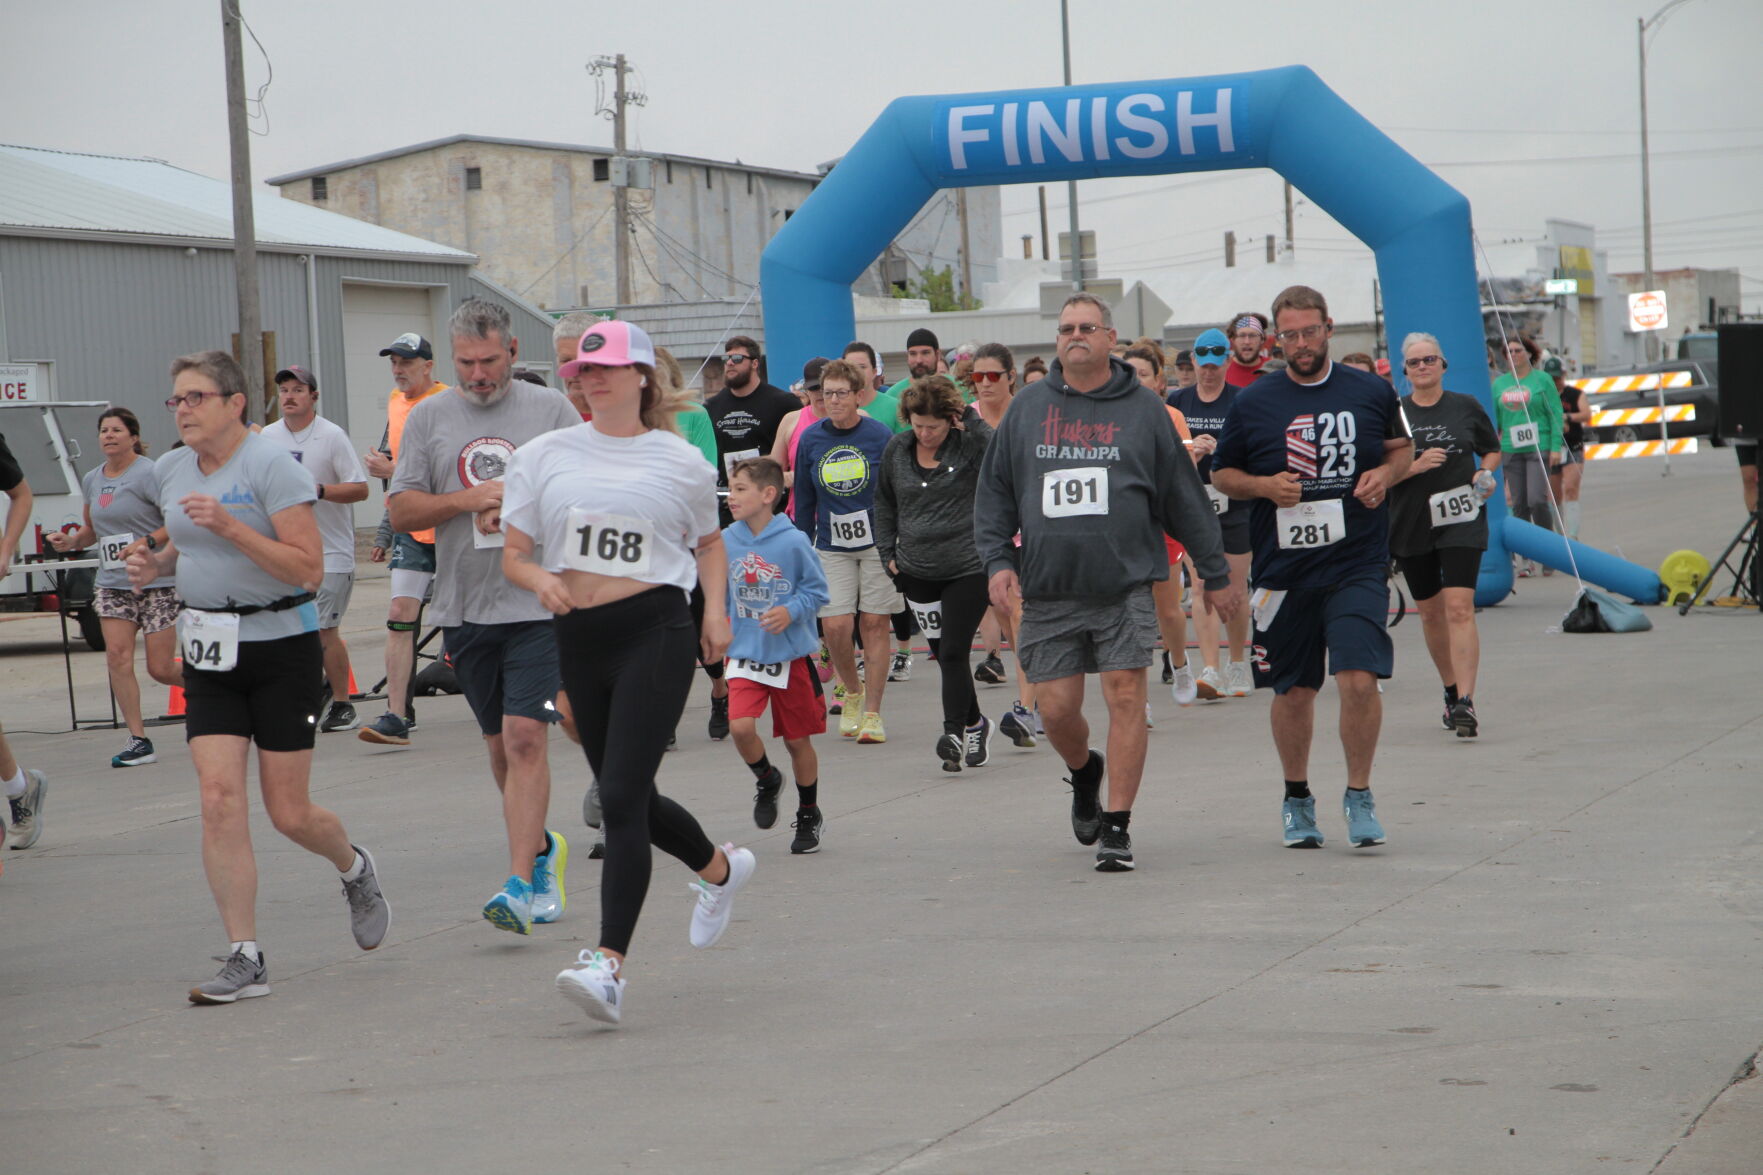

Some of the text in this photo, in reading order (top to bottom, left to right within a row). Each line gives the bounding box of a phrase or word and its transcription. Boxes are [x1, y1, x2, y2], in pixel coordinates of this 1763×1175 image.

[948, 88, 1235, 170] FINISH
[1301, 428, 1316, 441] 46
[1318, 411, 1356, 445] 20
[1517, 428, 1533, 442] 80
[1036, 444, 1120, 461] GRANDPA
[1319, 444, 1356, 478] 23
[1050, 478, 1098, 506] 191
[1436, 493, 1473, 518] 195
[832, 519, 867, 541] 188
[1290, 523, 1330, 546] 281
[576, 524, 643, 563] 168
